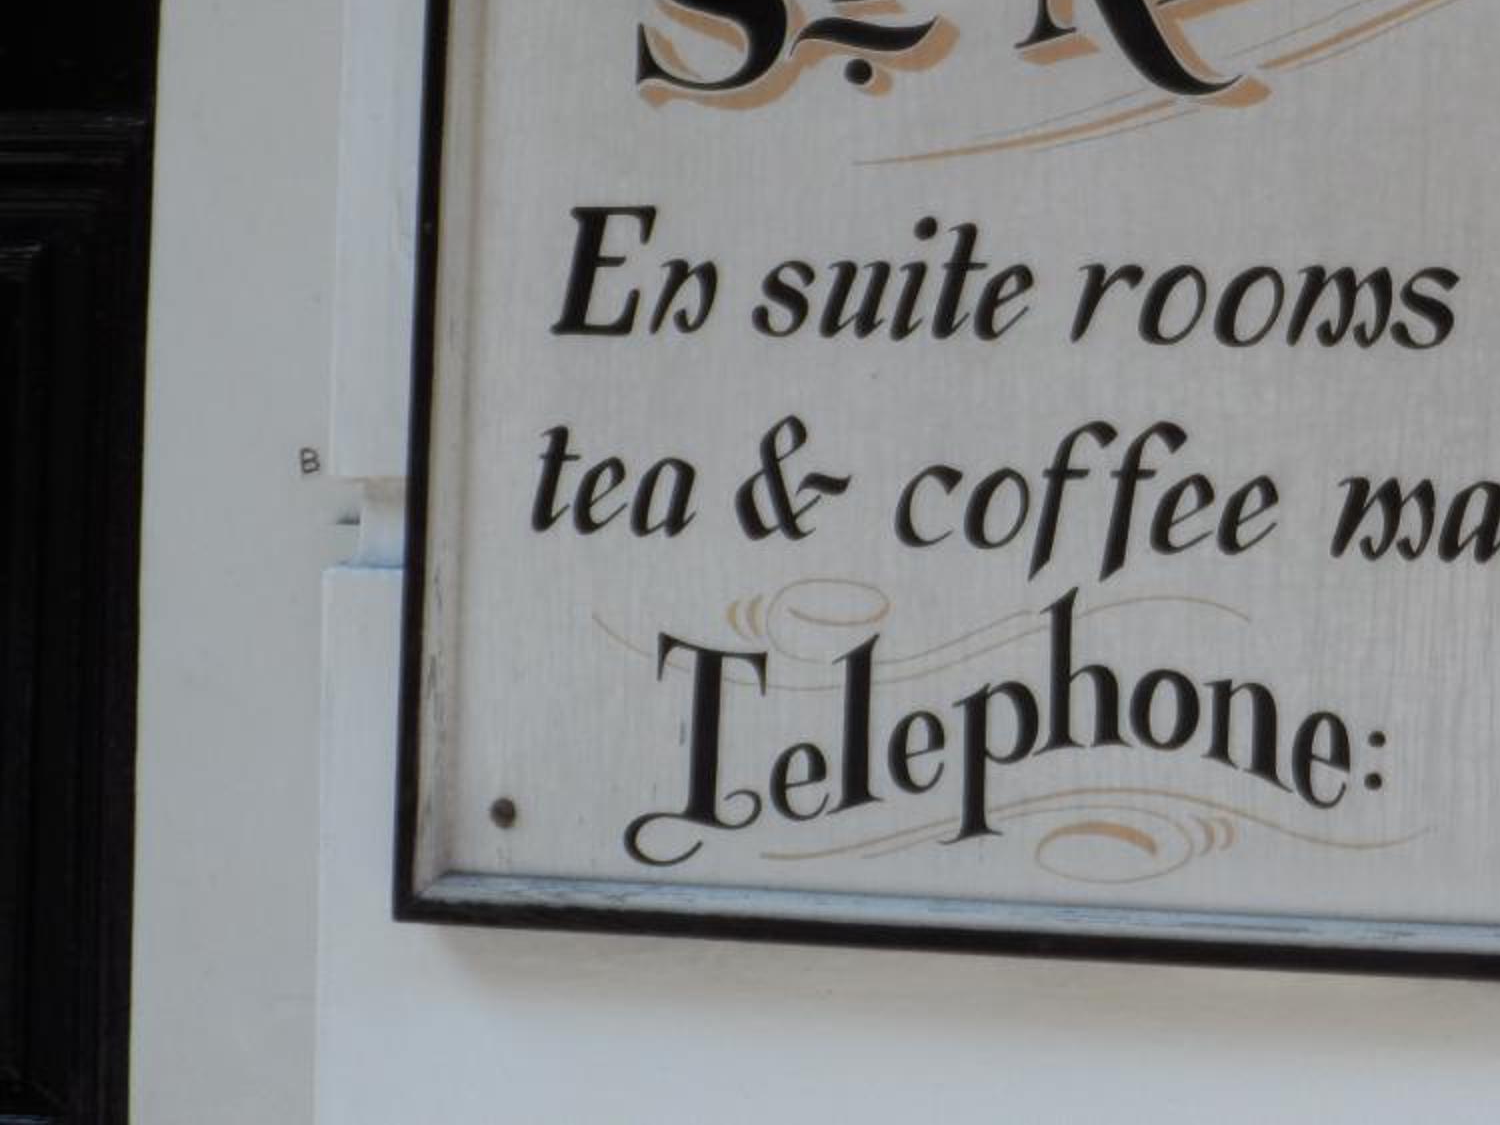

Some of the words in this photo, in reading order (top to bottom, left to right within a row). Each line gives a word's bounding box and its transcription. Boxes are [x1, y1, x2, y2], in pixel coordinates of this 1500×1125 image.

[550, 204, 719, 337] En
[751, 216, 1034, 342] suite
[1070, 262, 1460, 350] rooms
[530, 425, 697, 538] tea
[735, 415, 851, 542] &
[895, 420, 1280, 582] coffee
[624, 587, 1388, 867] Telephone:
